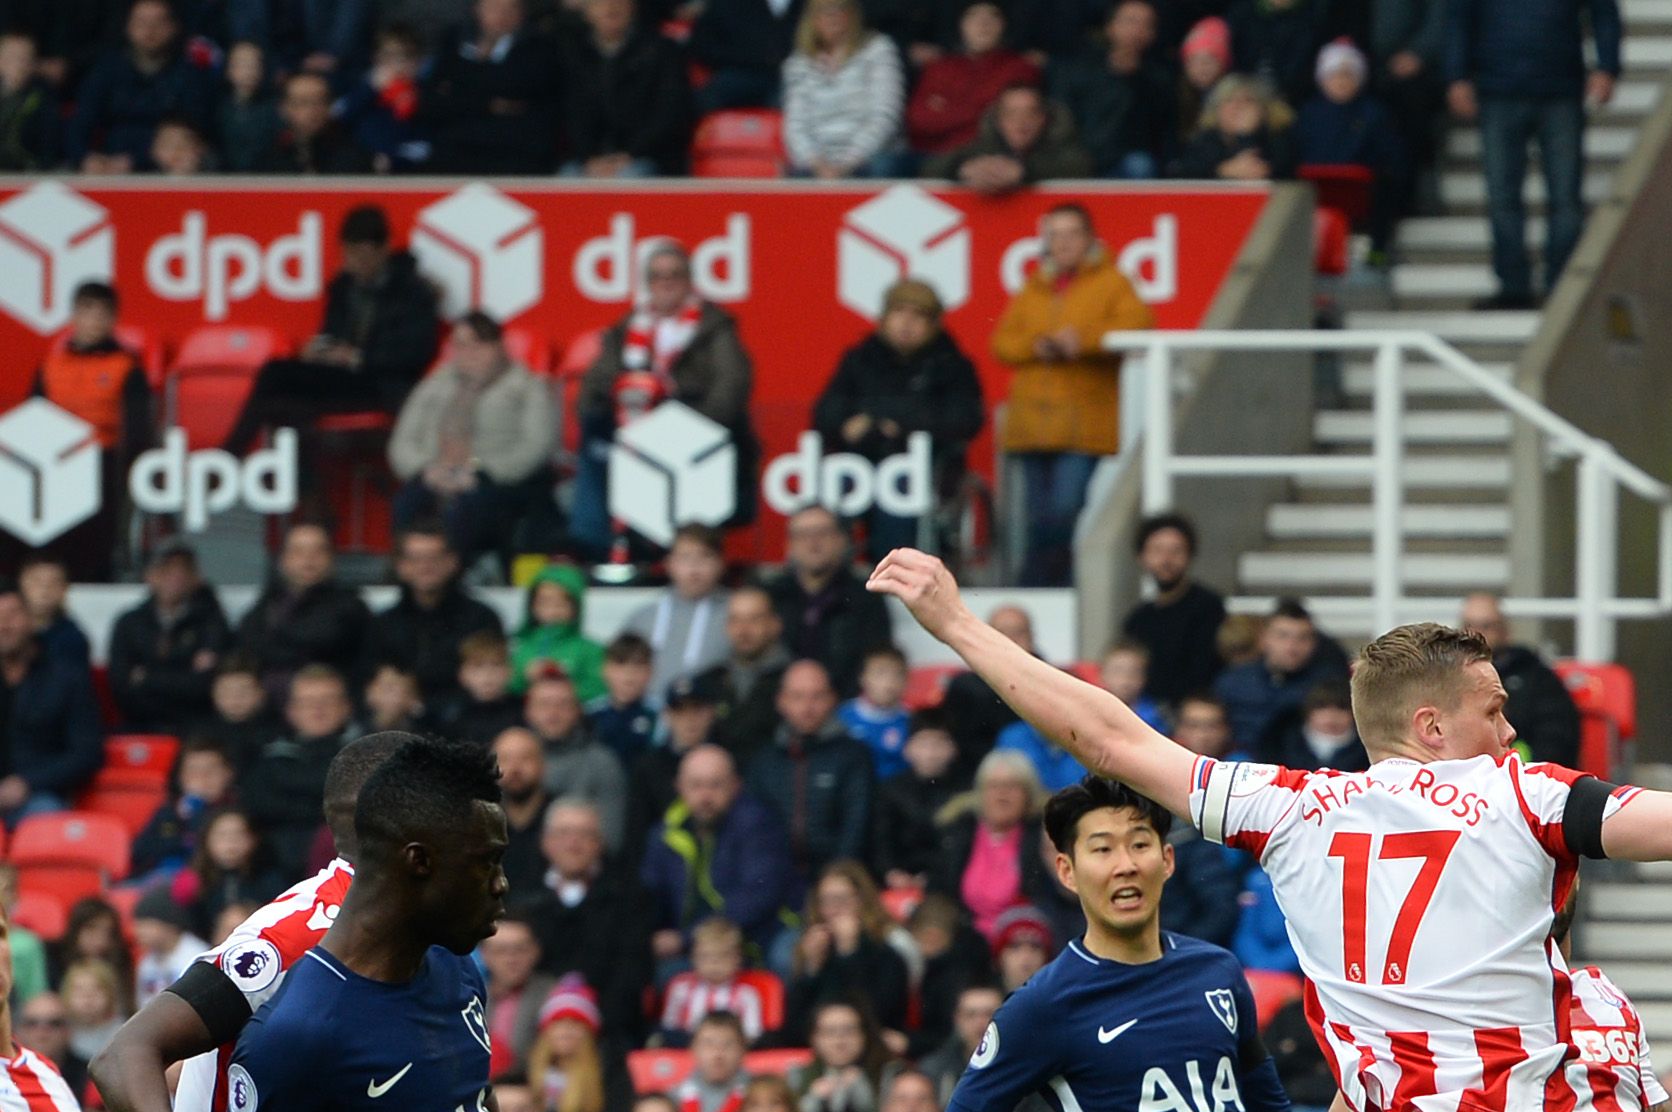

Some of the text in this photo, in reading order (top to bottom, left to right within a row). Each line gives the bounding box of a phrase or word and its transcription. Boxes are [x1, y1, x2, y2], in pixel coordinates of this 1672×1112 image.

[146, 211, 323, 320] dpd
[129, 427, 299, 533] dpd
[1302, 767, 1489, 827] SHAROSS
[1327, 829, 1462, 985] 17
